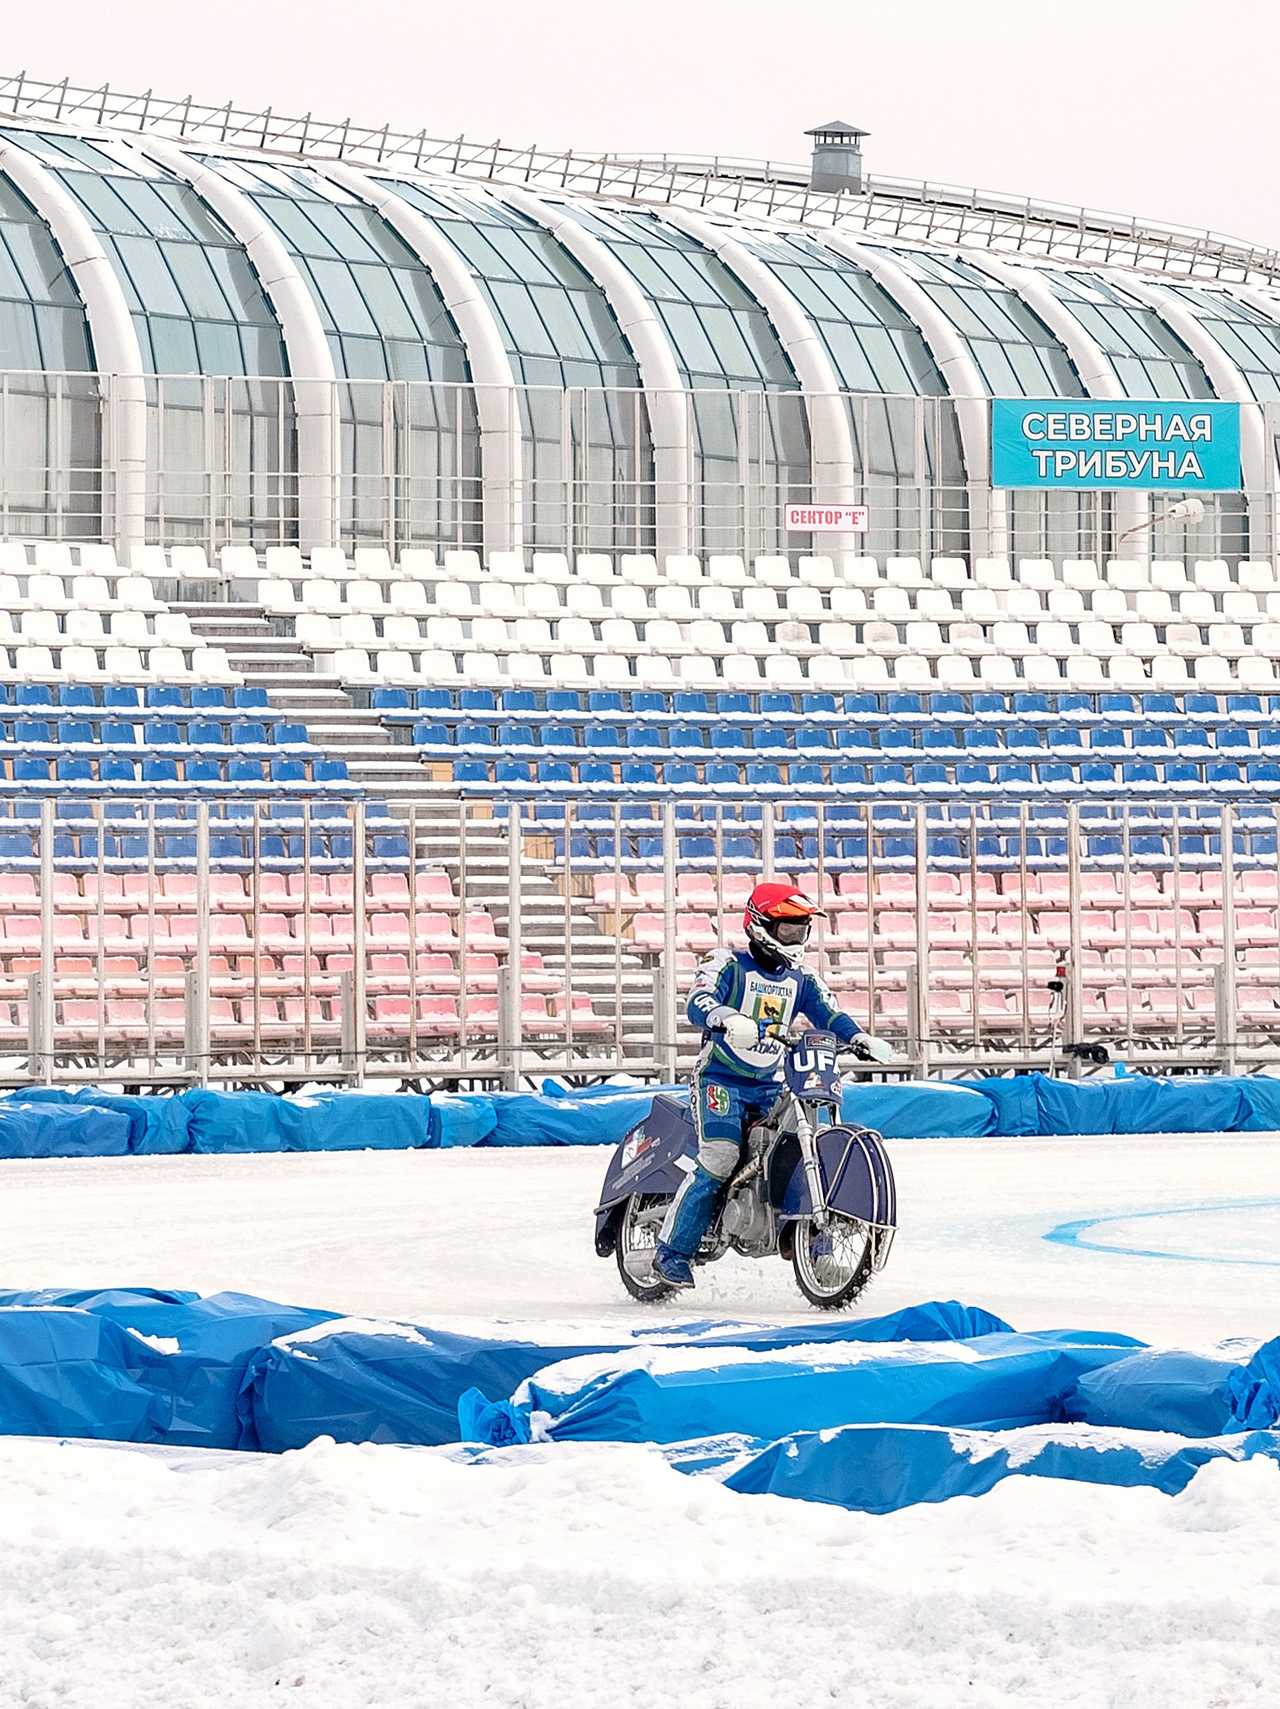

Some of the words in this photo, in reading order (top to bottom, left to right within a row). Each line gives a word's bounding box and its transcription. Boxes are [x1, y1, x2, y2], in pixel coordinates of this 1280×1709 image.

[1022, 412, 1212, 442] СЕВЕРНАЯ
[1031, 450, 1204, 479] ТРИБУНА
[790, 510, 842, 524] СЕКТОР
